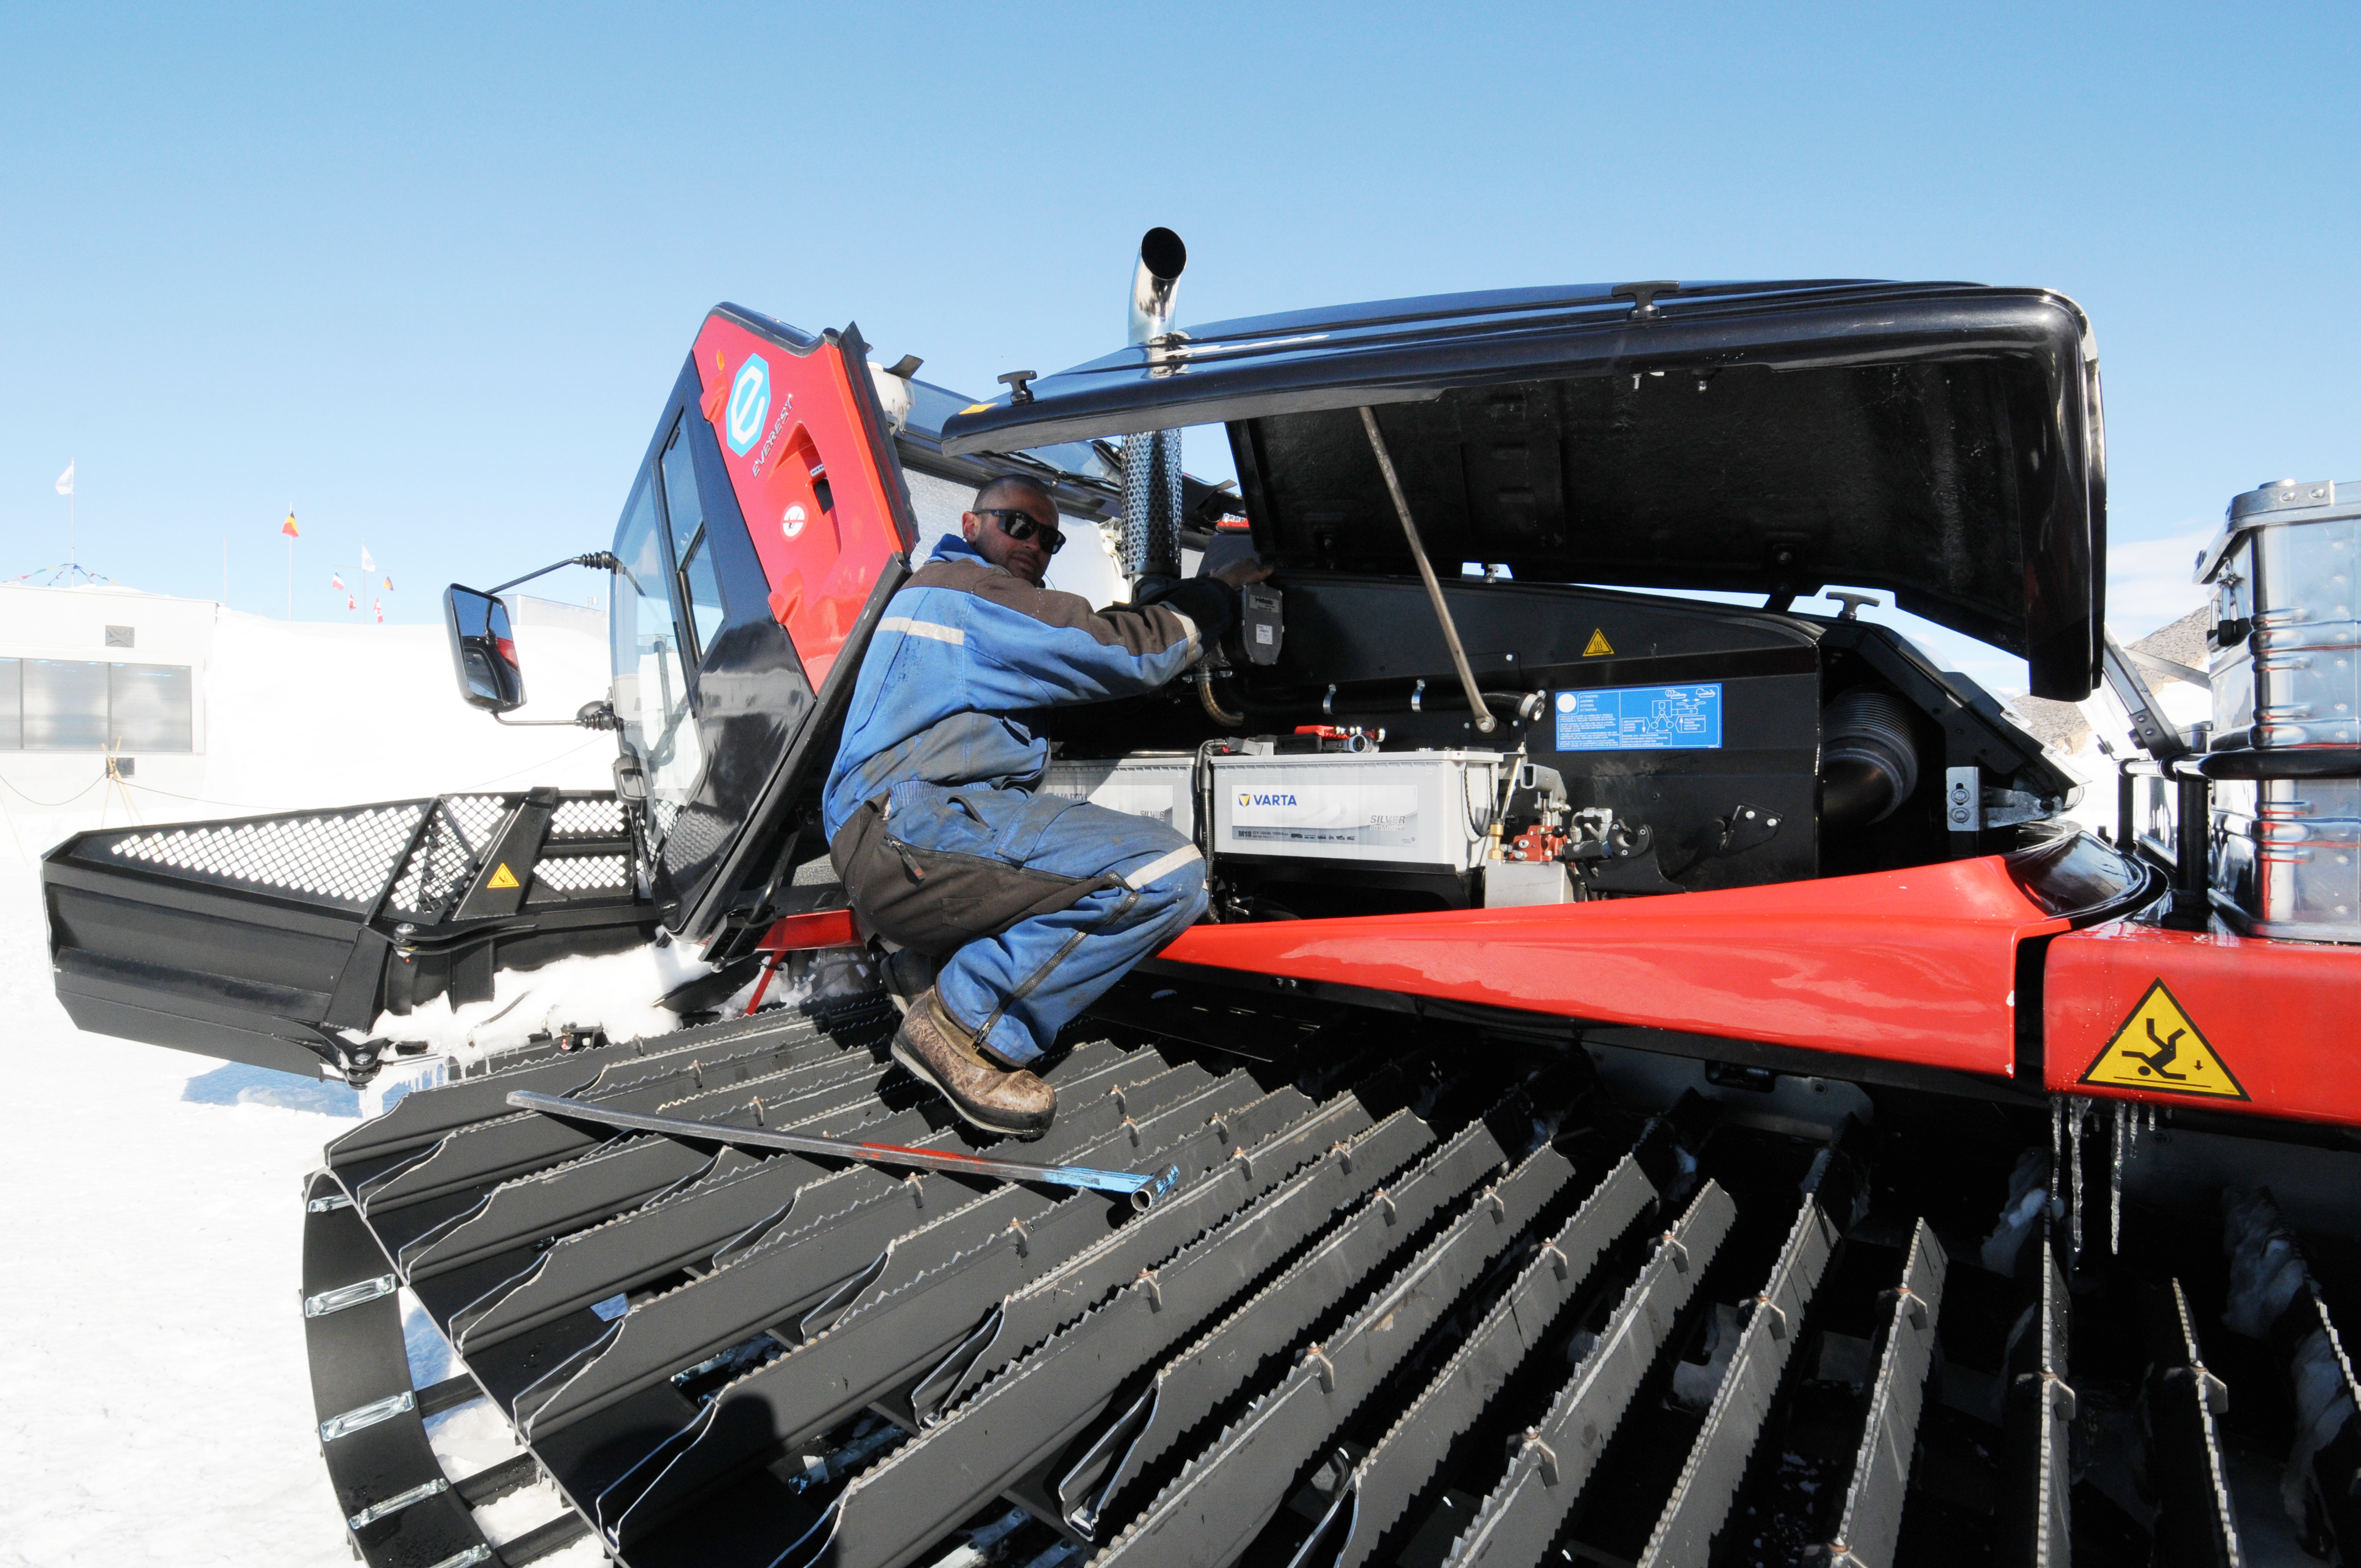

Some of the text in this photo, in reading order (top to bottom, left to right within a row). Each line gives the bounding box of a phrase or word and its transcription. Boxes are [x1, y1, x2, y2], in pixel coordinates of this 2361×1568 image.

[752, 393, 793, 478] EVEREST
[1253, 794, 1297, 806] VARTA
[1370, 815, 1406, 824] SILVER
